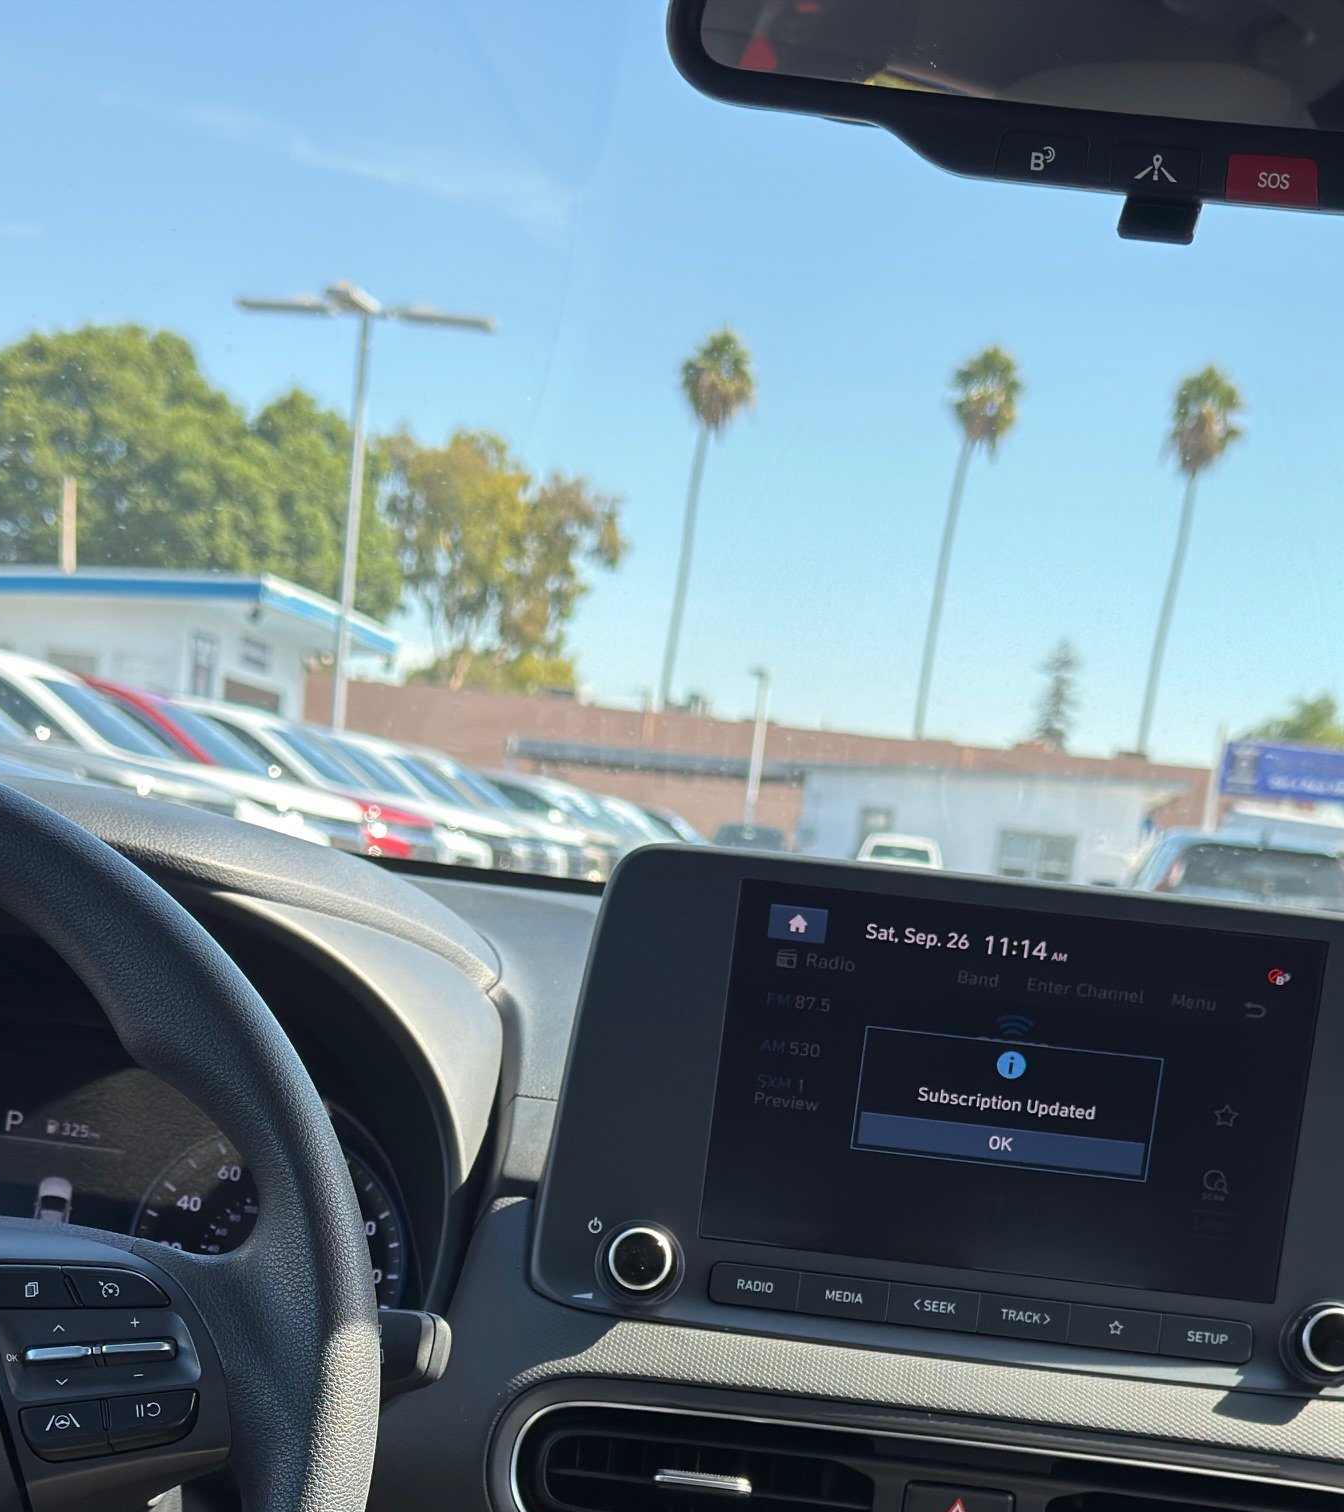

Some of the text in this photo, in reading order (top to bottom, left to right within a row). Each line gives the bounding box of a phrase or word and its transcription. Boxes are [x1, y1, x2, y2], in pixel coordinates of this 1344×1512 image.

[1257, 172, 1291, 190] SOS
[865, 923, 1068, 963] Sat, Sep. 26 11:14 AM
[806, 953, 856, 972] Radio
[957, 970, 999, 988] Band
[1027, 977, 1145, 1005] Enter Channel
[766, 991, 831, 1012] FM 87.5
[1171, 993, 1217, 1012] Menu
[759, 1038, 821, 1058] AM 530
[757, 1074, 791, 1089] SXM
[754, 1092, 819, 1111] Preview
[918, 1087, 1097, 1121] Subscription Updated
[5, 1109, 24, 1132] P
[989, 1135, 1014, 1152] OK
[217, 1165, 242, 1181] 60
[176, 1195, 201, 1212] 40
[736, 1278, 774, 1294] RADIO
[825, 1289, 863, 1304] MEDIA
[923, 1299, 956, 1314] SEEK
[1001, 1308, 1040, 1324] TRACK
[1187, 1330, 1229, 1345] SETUP
[6, 1353, 19, 1362] OK
